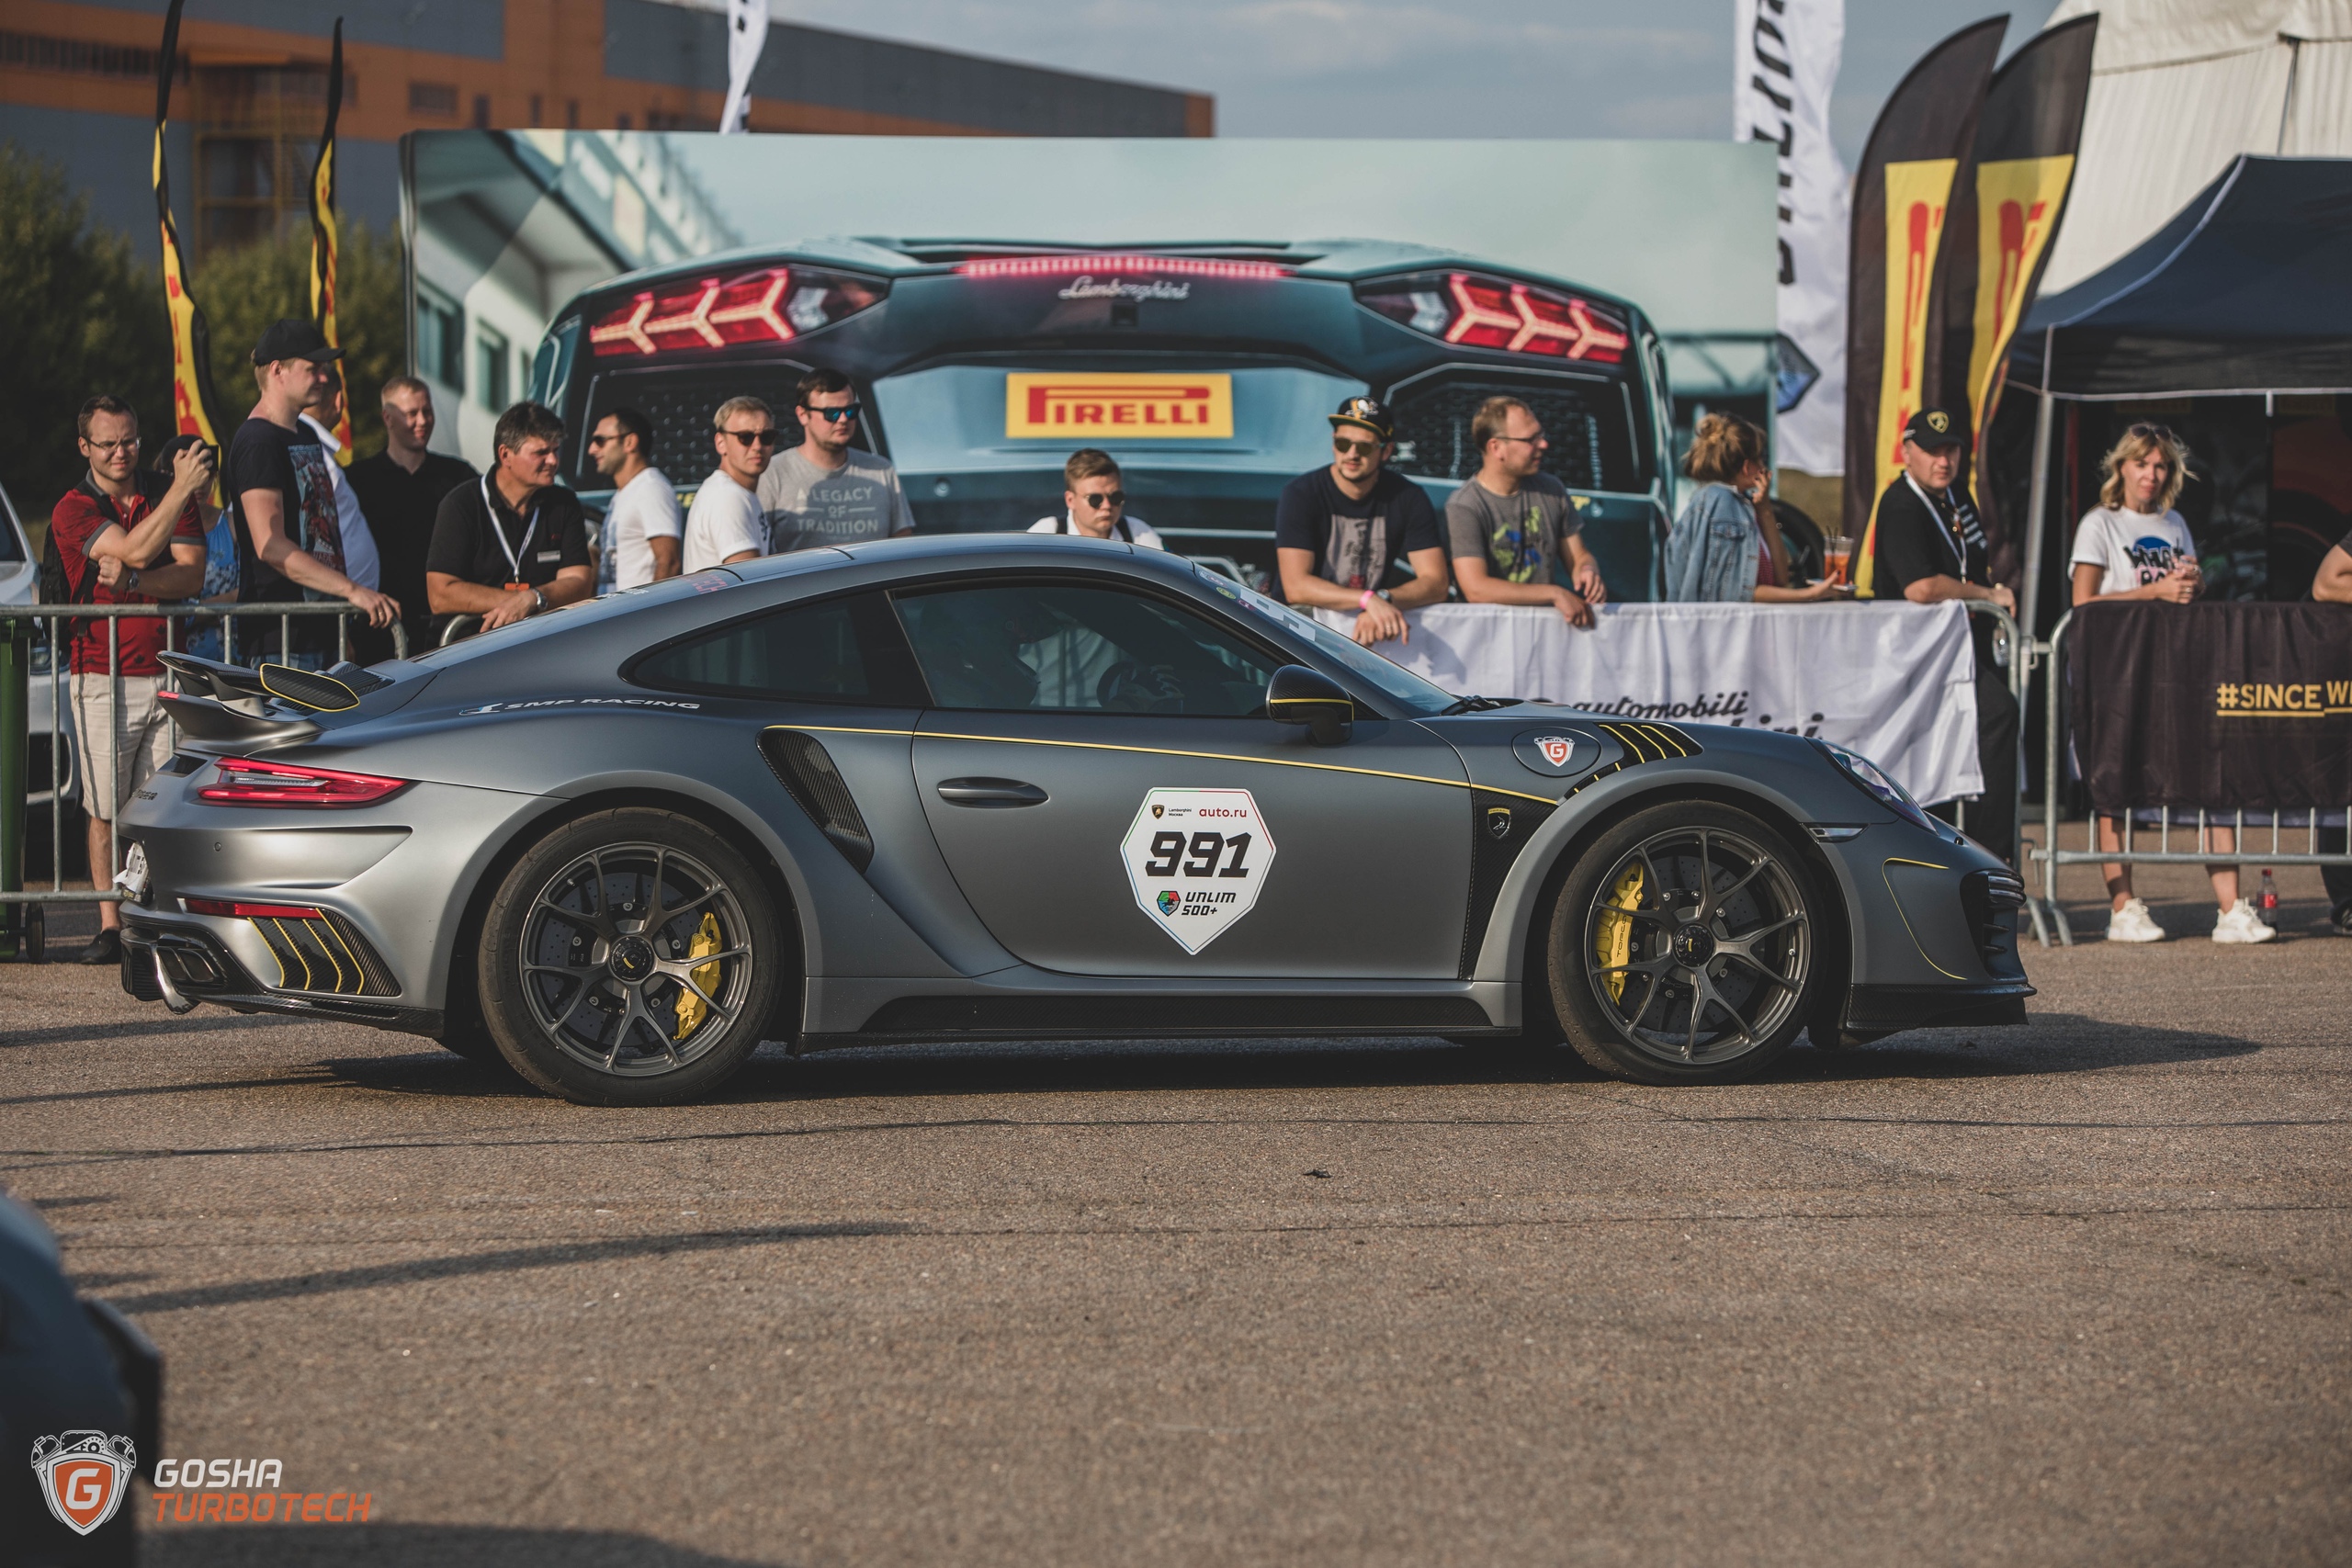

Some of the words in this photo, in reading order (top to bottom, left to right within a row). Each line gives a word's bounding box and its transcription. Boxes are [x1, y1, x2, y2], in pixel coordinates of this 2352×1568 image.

[1057, 275, 1191, 303] Lamborghini
[1027, 386, 1210, 424] PIRELLI
[812, 486, 873, 502] LEGACY
[828, 505, 848, 519] OF
[797, 518, 879, 536] TRADITION
[504, 698, 575, 710] SMP
[581, 698, 700, 710] RACING
[1199, 807, 1247, 818] auto.ru
[1145, 831, 1252, 877] 991
[1185, 891, 1237, 903] UNLIM
[1182, 905, 1217, 916] 500+
